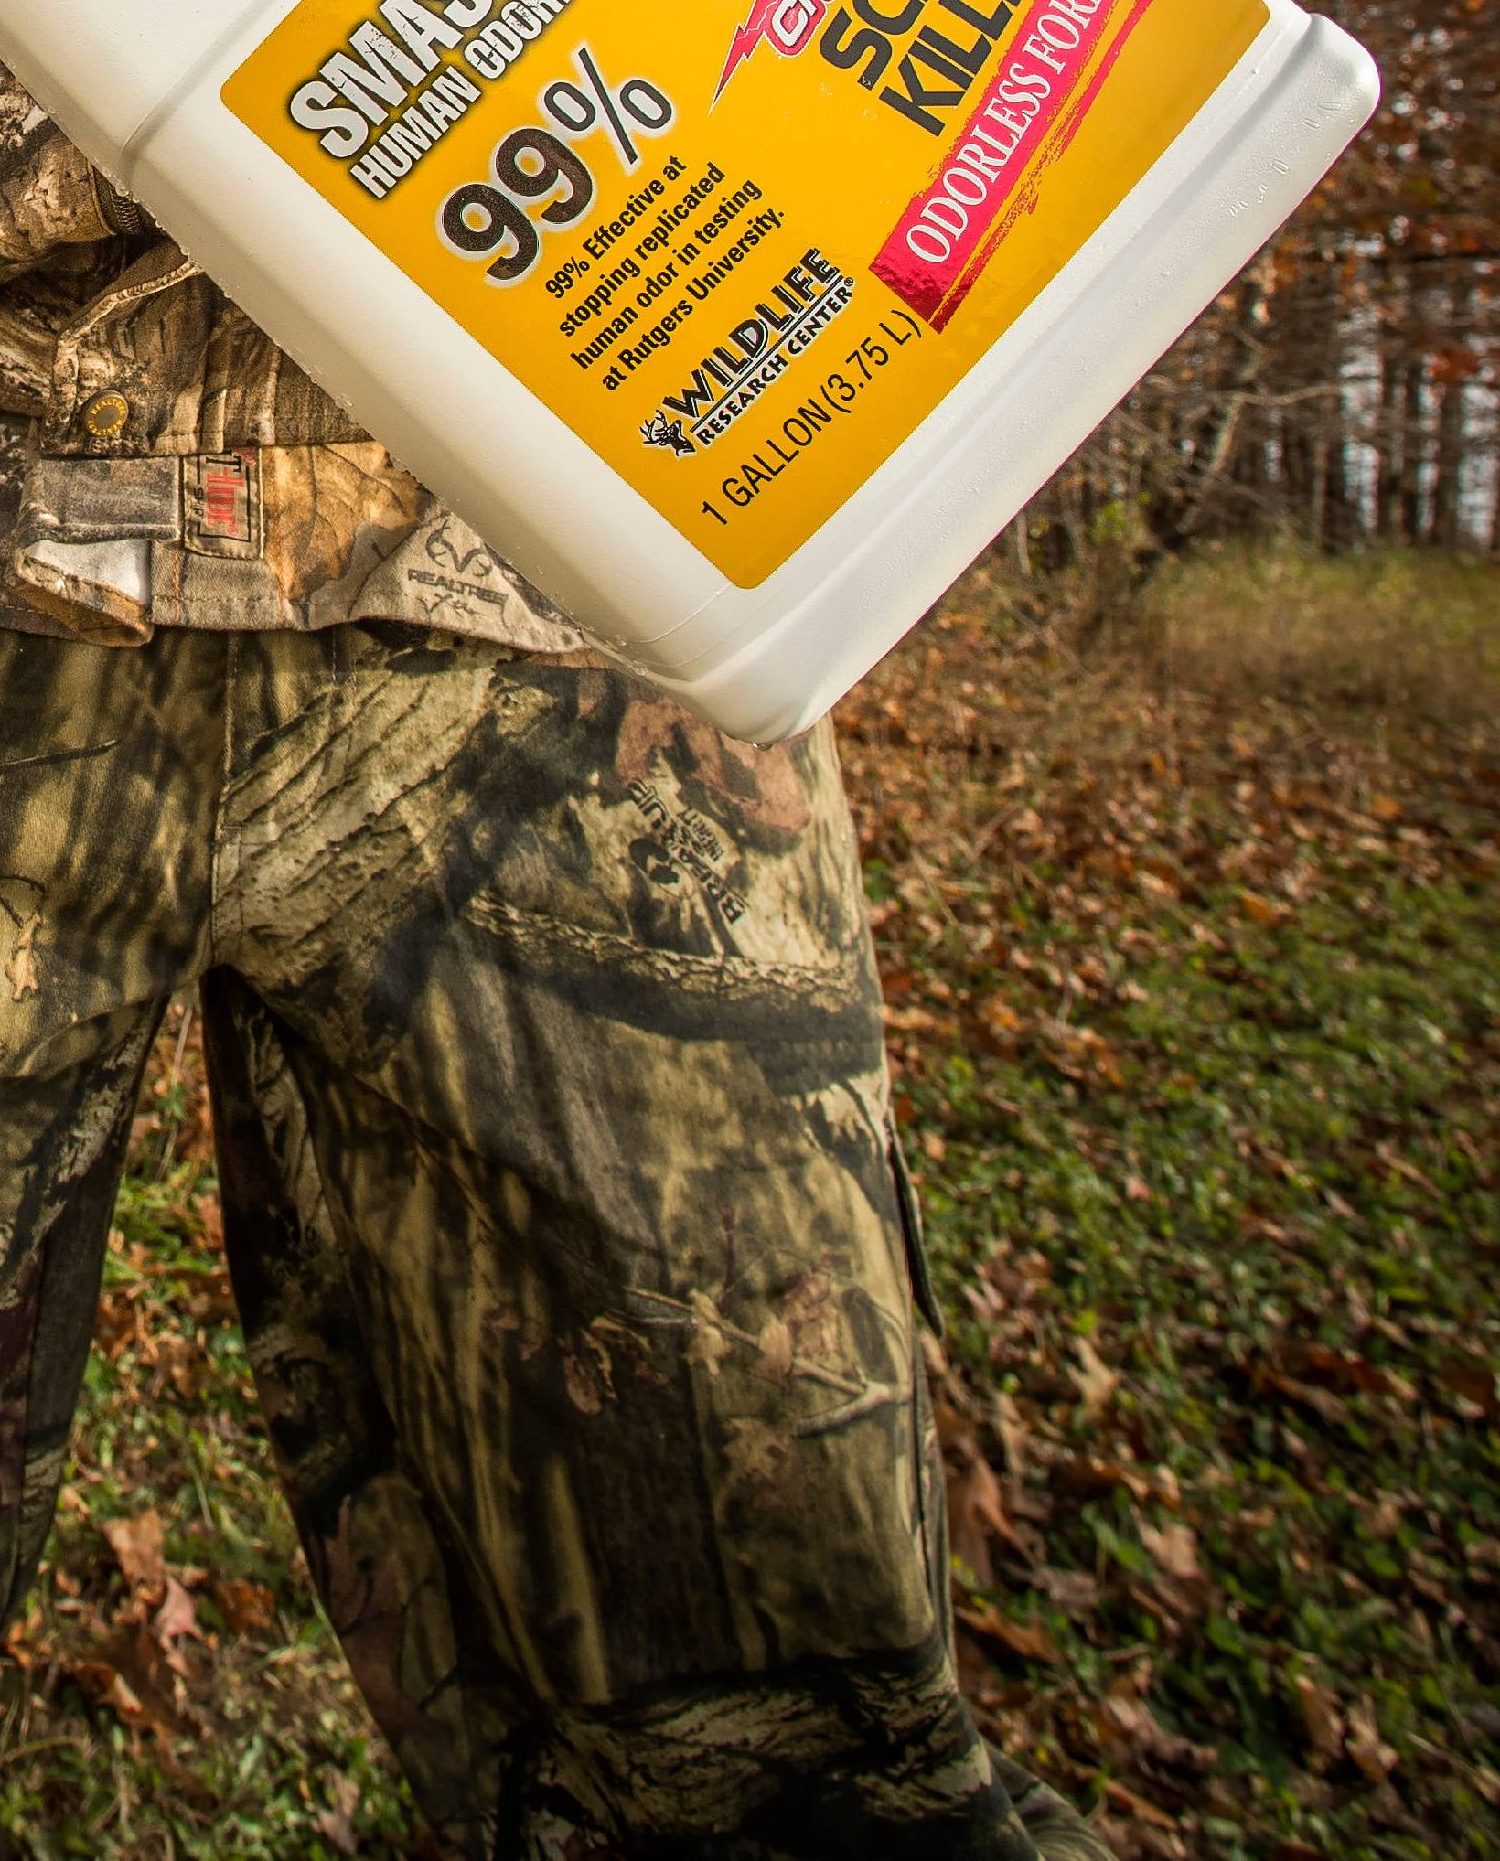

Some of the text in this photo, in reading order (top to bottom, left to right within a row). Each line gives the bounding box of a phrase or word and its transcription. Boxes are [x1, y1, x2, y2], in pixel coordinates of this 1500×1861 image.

[349, 69, 481, 199] HUMAN
[440, 47, 674, 283] 99%
[905, 57, 1052, 266] ODORLESS
[545, 155, 688, 300] 99% Effective at
[559, 161, 727, 339] stopping replicated
[571, 178, 764, 373] human odor in testing
[602, 208, 787, 392] at Rutgers University.
[662, 248, 842, 421] WILDLIFE
[696, 285, 854, 446] RESEARCH CENTER
[701, 307, 924, 527] 1 GALLON (3.75 L)
